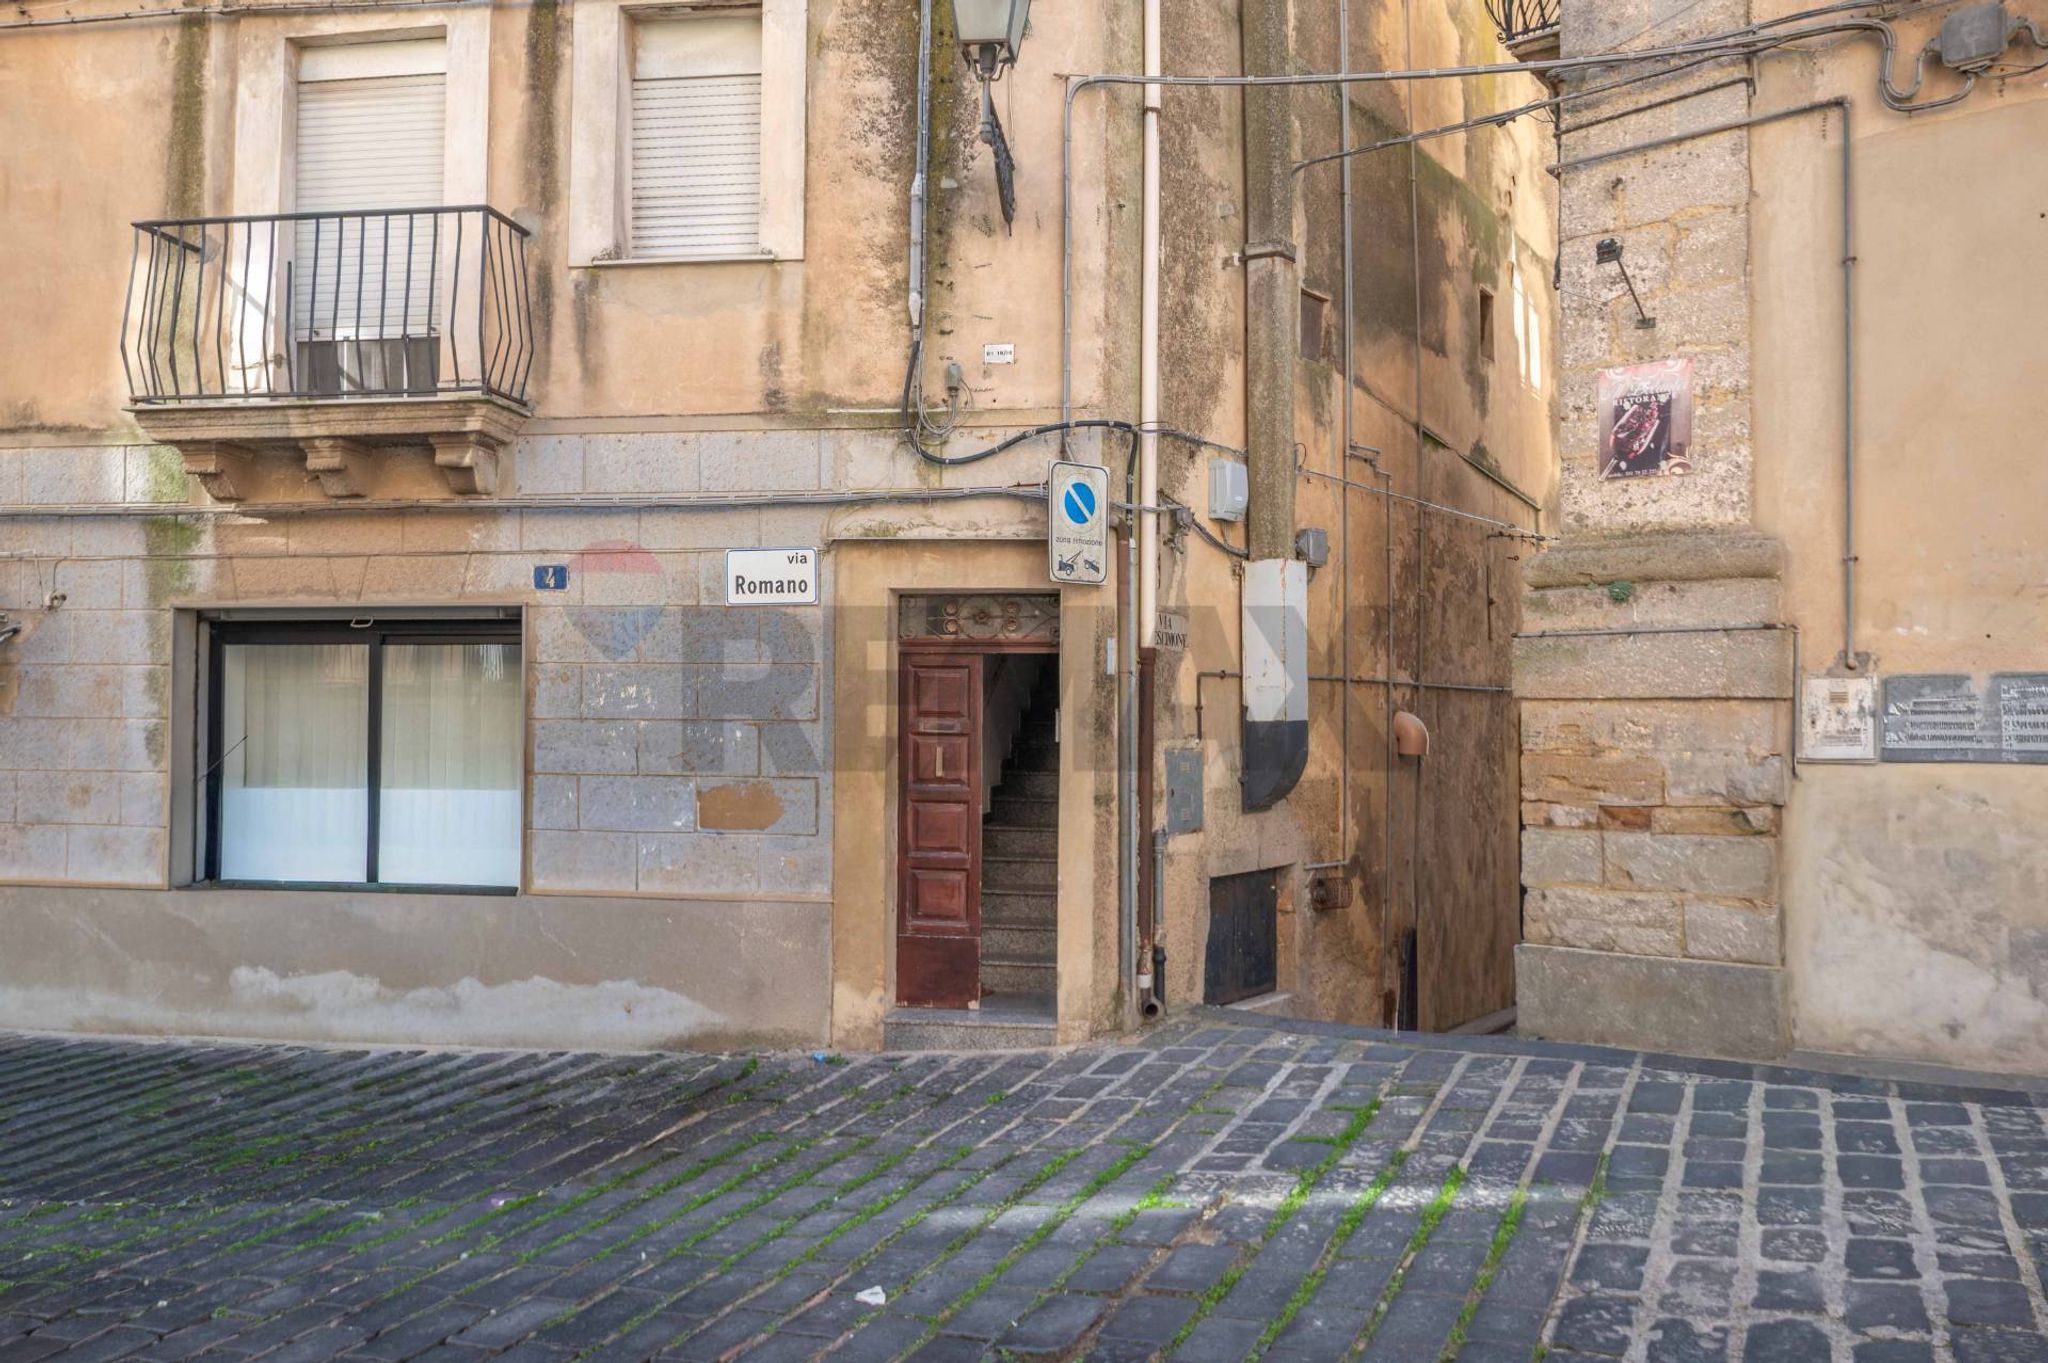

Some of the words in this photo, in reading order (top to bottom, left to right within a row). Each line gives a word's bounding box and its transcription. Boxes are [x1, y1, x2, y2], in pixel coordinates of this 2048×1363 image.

[787, 553, 808, 565] via
[545, 567, 556, 588] 4
[735, 575, 808, 595] Romano
[1158, 613, 1173, 630] VIA
